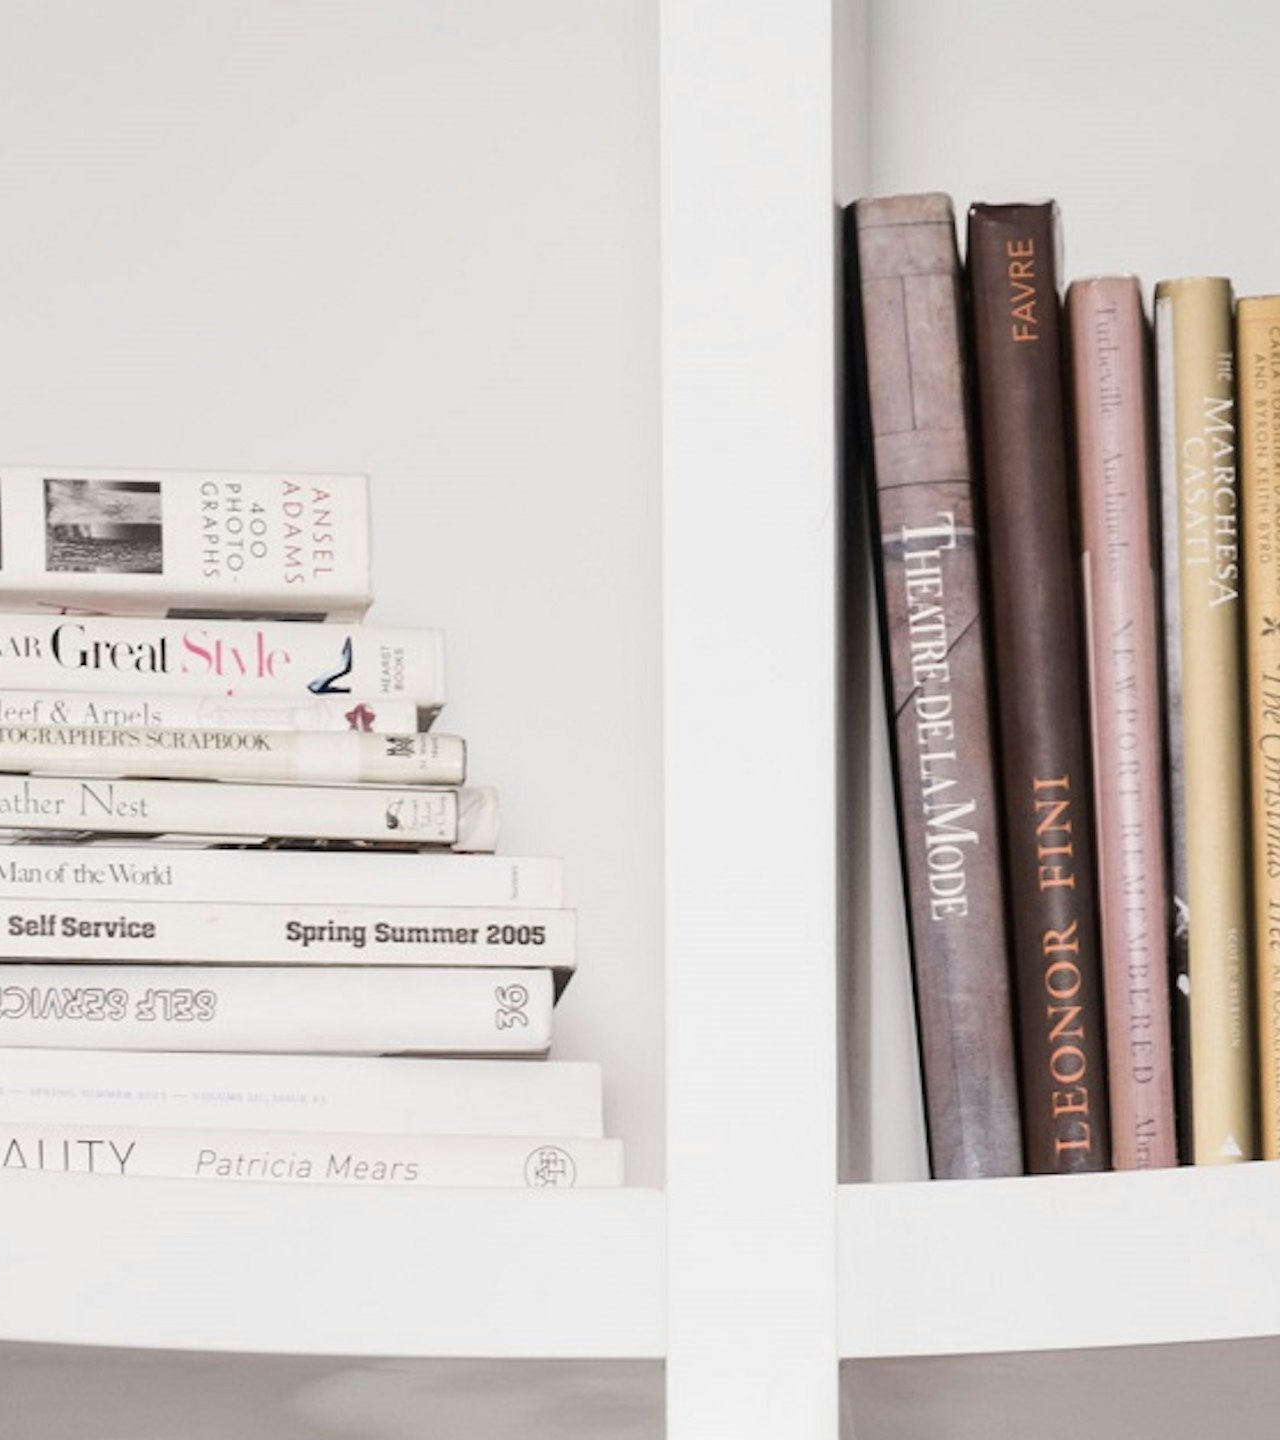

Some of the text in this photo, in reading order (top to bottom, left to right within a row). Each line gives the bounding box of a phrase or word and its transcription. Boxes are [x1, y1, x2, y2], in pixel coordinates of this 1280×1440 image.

[1007, 238, 1038, 344] FAVRE
[201, 481, 221, 579] GRAPHS
[249, 501, 268, 560] 400
[281, 480, 306, 586] ADAMS
[311, 486, 334, 579] ANSEL
[1182, 436, 1210, 567] CASATI
[51, 624, 171, 675] Great
[181, 629, 293, 698] Style
[49, 699, 70, 726] &
[81, 699, 164, 730] Arpels
[80, 784, 150, 819] Nest
[8, 915, 156, 939] Self Service
[286, 920, 546, 948] Spring Summer 2005
[1033, 776, 1092, 1156] LEONOR FINI
[196, 1149, 418, 1181] Patricia Mears
